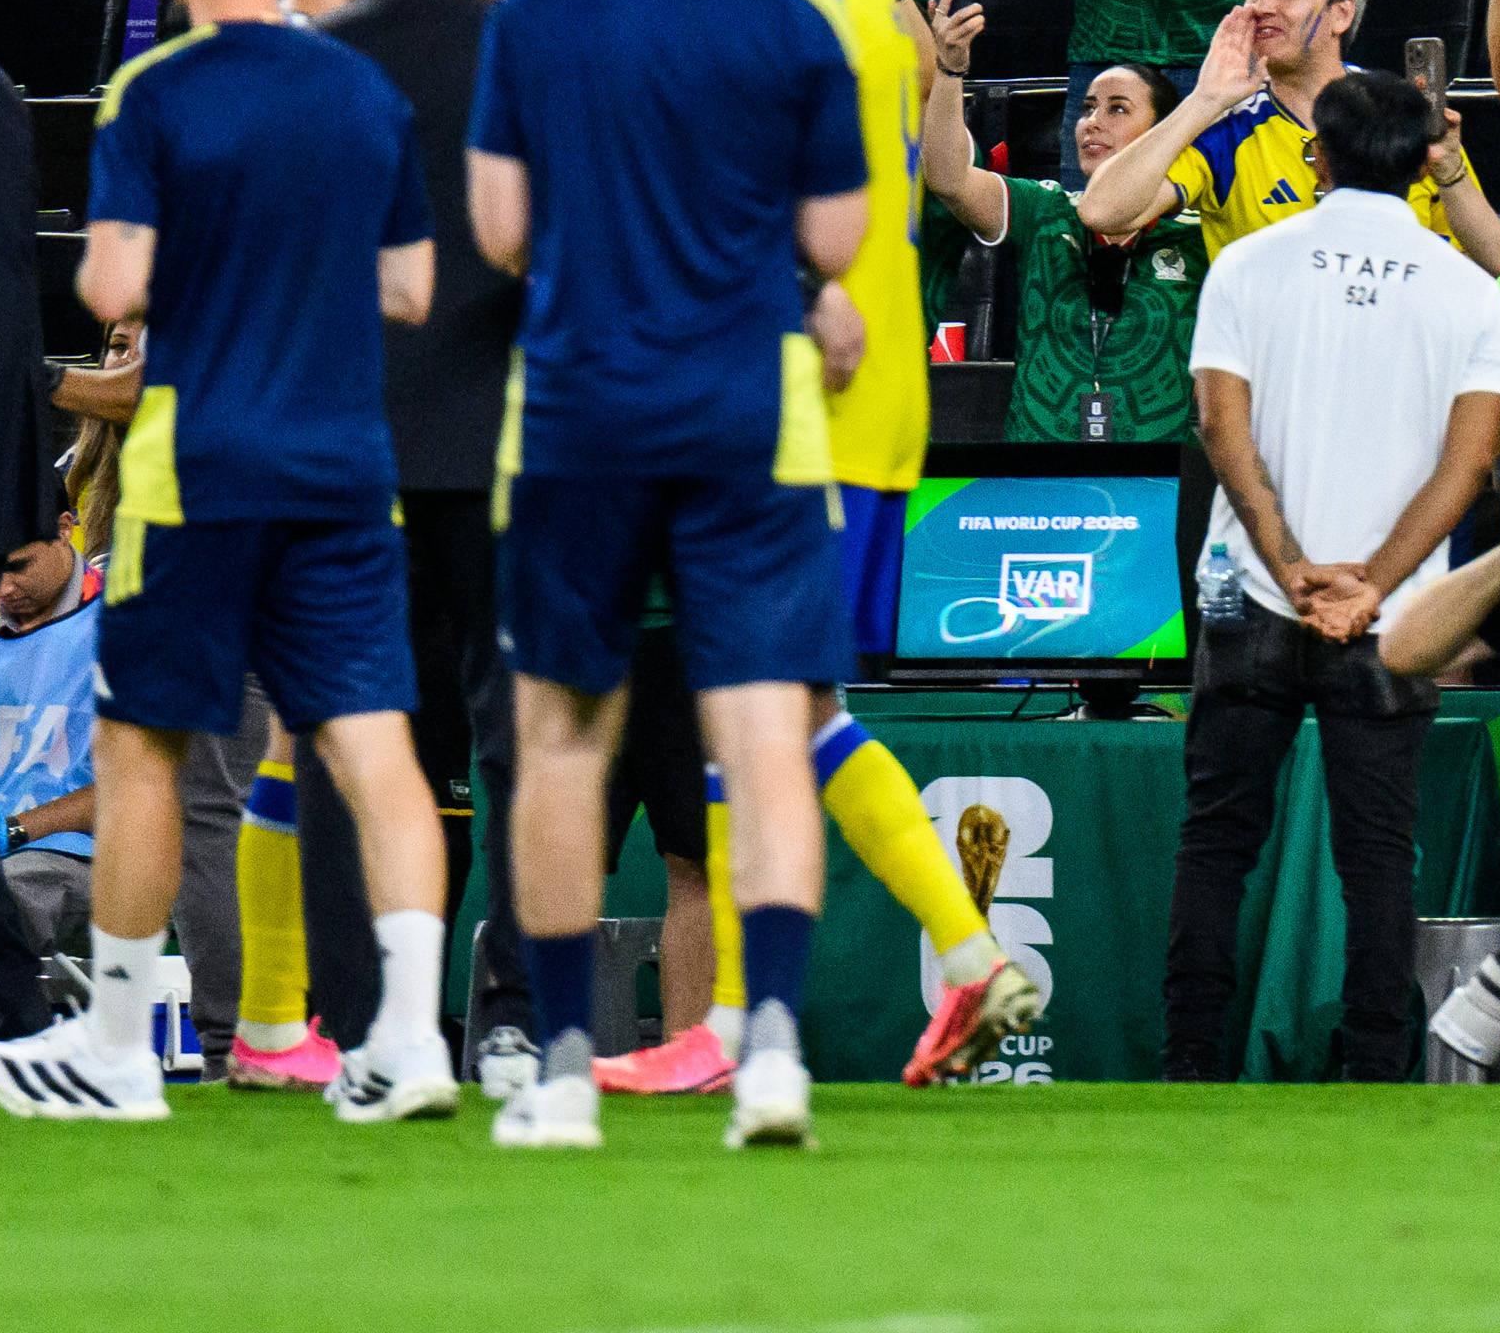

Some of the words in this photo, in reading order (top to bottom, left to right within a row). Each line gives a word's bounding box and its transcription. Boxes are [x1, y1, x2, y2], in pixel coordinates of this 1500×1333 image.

[1311, 249, 1422, 283] STAFF
[1344, 284, 1378, 308] 524
[958, 516, 992, 531] FIFA
[993, 516, 1051, 531] WORLD
[1051, 516, 1082, 531] CUP
[1082, 516, 1139, 531] 2026
[1011, 570, 1081, 600] VAR
[999, 1035, 1054, 1057] CUP
